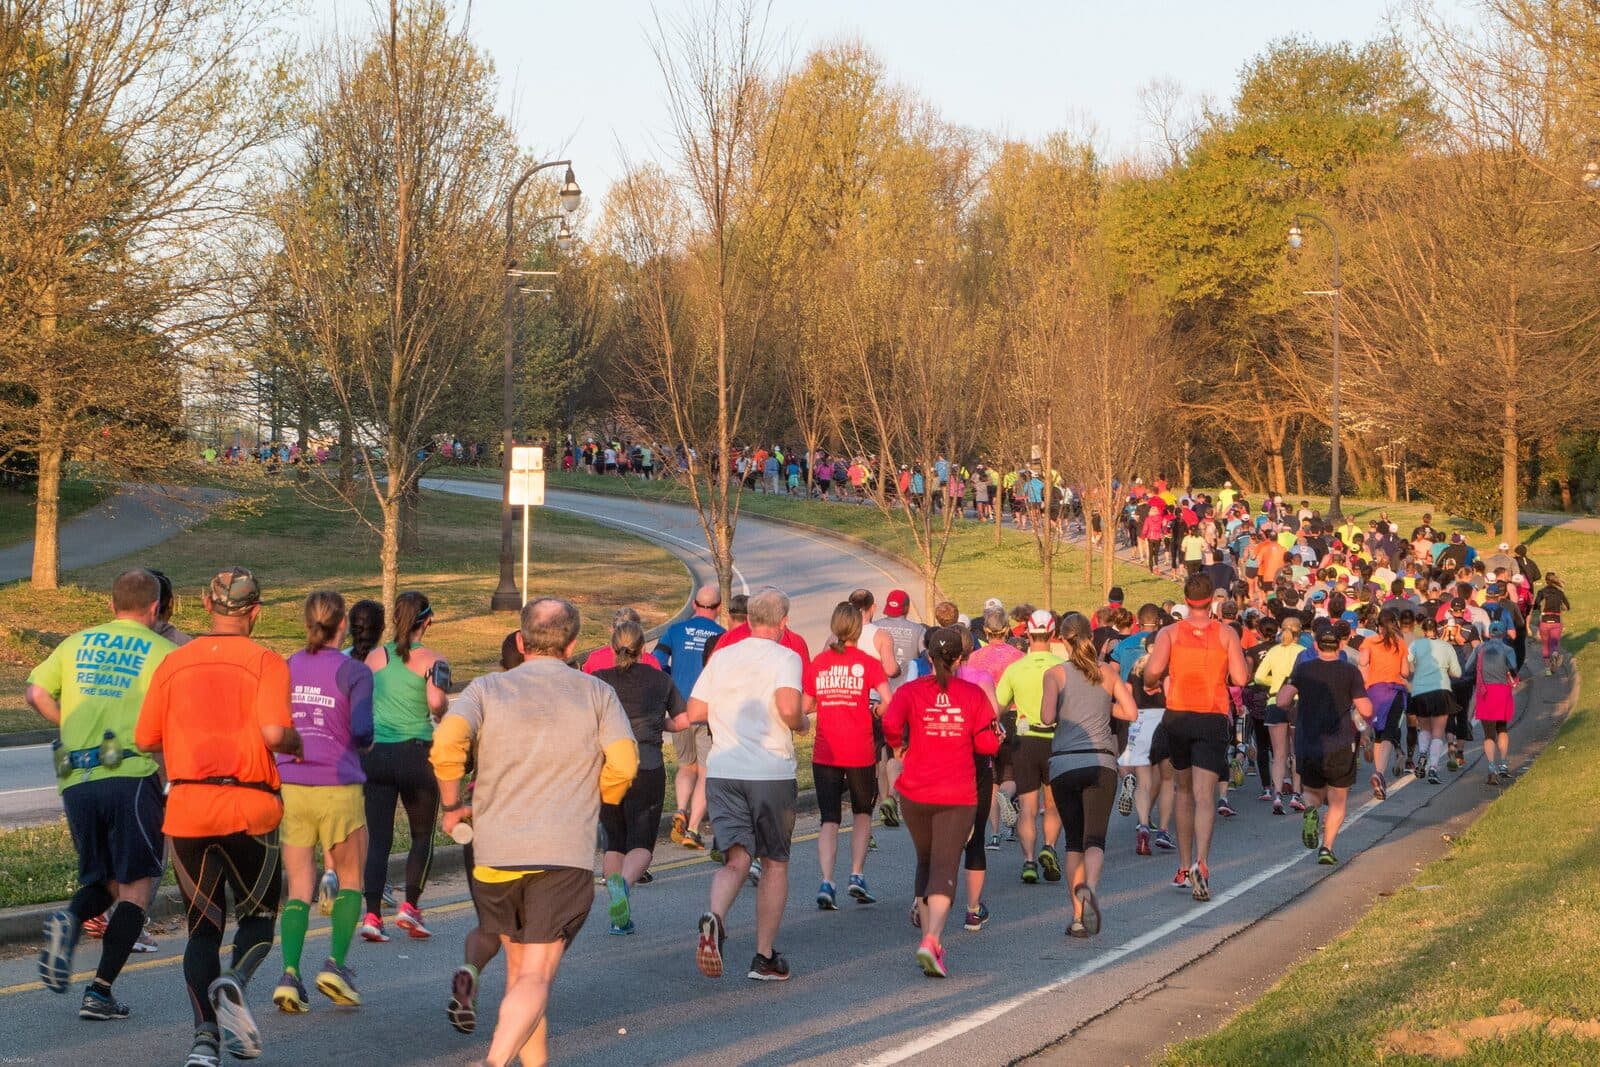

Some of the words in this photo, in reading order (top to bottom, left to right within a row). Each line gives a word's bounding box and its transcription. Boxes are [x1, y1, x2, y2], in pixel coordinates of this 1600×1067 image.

[82, 632, 152, 654] TRAIN
[76, 649, 144, 670] INSANE
[829, 665, 848, 676] JOHN
[76, 672, 131, 688] REMAIN
[816, 676, 864, 690] BREAKFIELD
[80, 687, 96, 695] THE
[306, 695, 332, 704] CHAPTER
